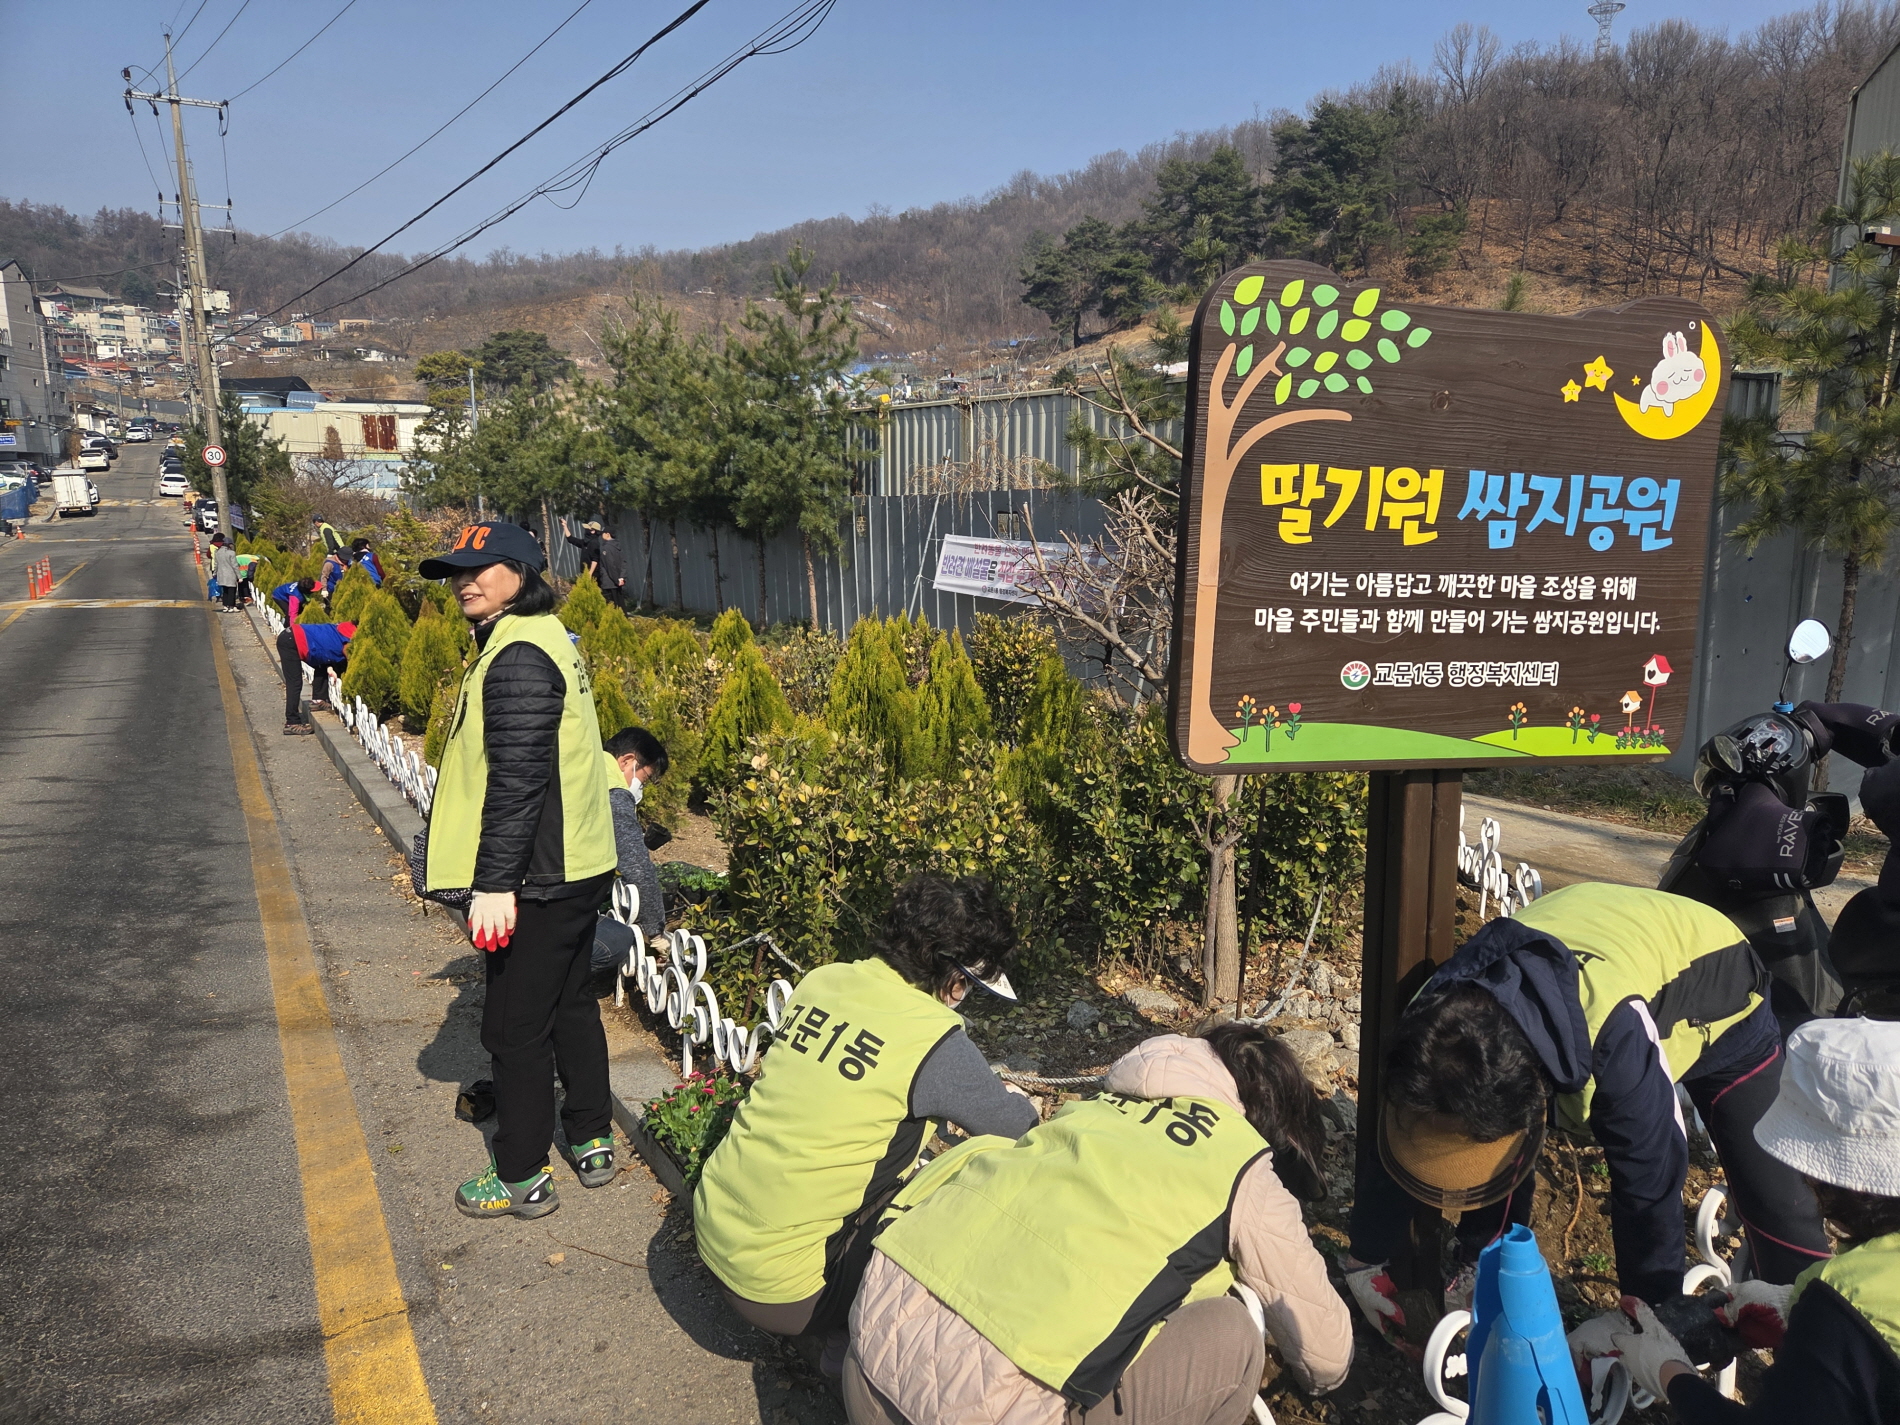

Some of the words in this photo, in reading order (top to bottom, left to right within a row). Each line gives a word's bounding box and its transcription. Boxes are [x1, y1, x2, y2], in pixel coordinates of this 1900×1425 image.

[207, 451, 221, 461] 30
[1261, 464, 1444, 546] 딸기원
[1457, 470, 1681, 552] 쌈지공원
[974, 543, 1002, 557] 반려동물
[941, 554, 965, 577] 반려견
[965, 556, 998, 581] 배설물은
[1290, 571, 1349, 597] 여기는
[1356, 572, 1432, 598] 아름답고
[1437, 573, 1496, 599] 깨끗한
[1500, 574, 1537, 599] 마을
[1541, 575, 1597, 601] 조성을
[1601, 576, 1637, 601] 위해
[1254, 607, 1295, 633] 마을
[1300, 608, 1380, 634] 주민들과
[1386, 608, 1424, 634] 함께
[1430, 609, 1485, 634] 만들어
[1491, 610, 1528, 634] 가는
[1532, 610, 1661, 635] 쌈지공원입니다.
[1373, 661, 1444, 688] 교문1동
[1448, 661, 1559, 688] 행정복지센터
